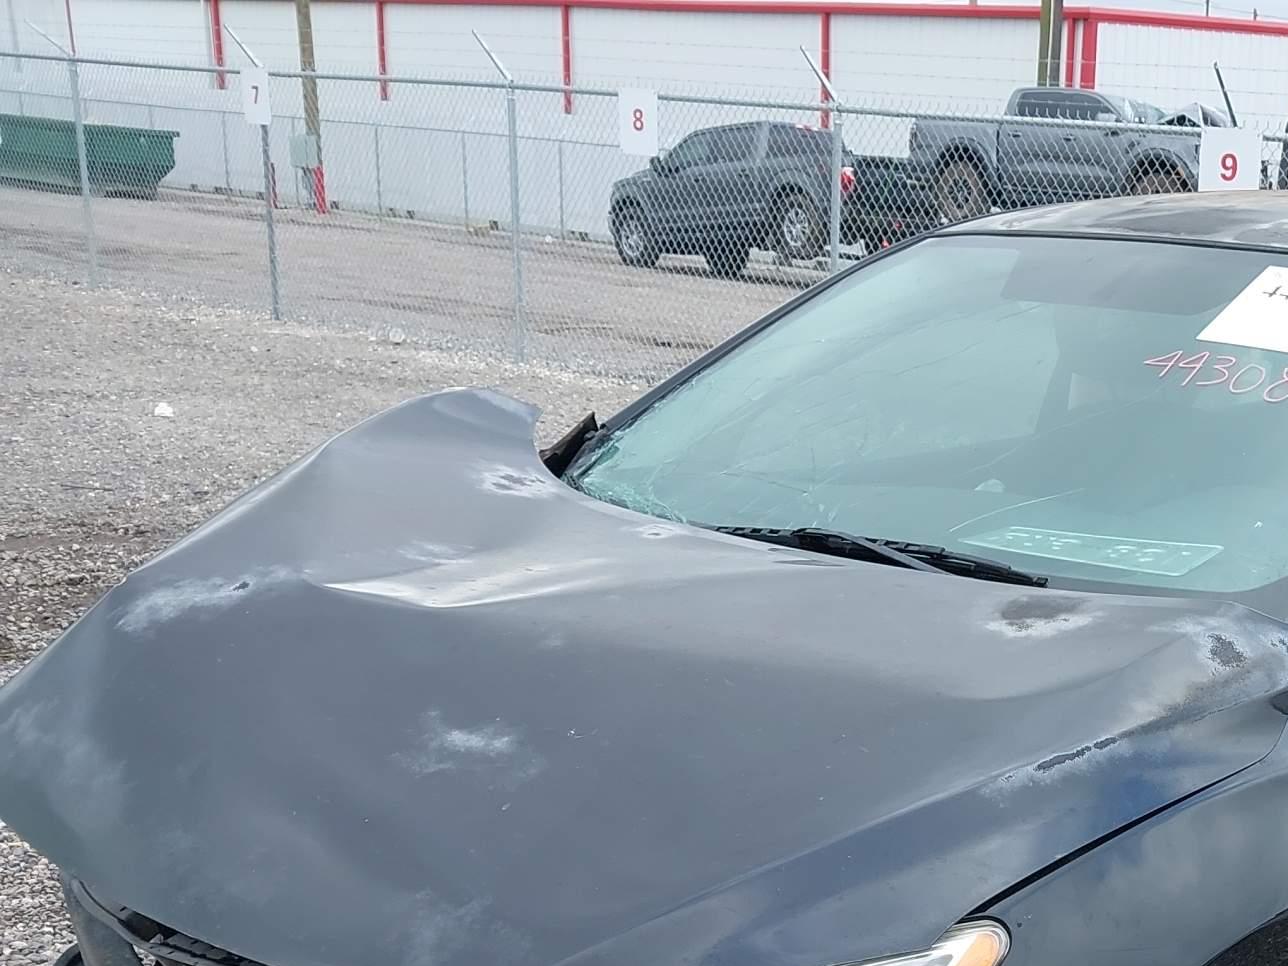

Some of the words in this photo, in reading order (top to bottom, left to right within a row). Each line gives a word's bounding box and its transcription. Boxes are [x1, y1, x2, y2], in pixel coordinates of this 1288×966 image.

[251, 85, 259, 104] 7
[633, 108, 644, 131] 8
[1220, 153, 1238, 181] 9
